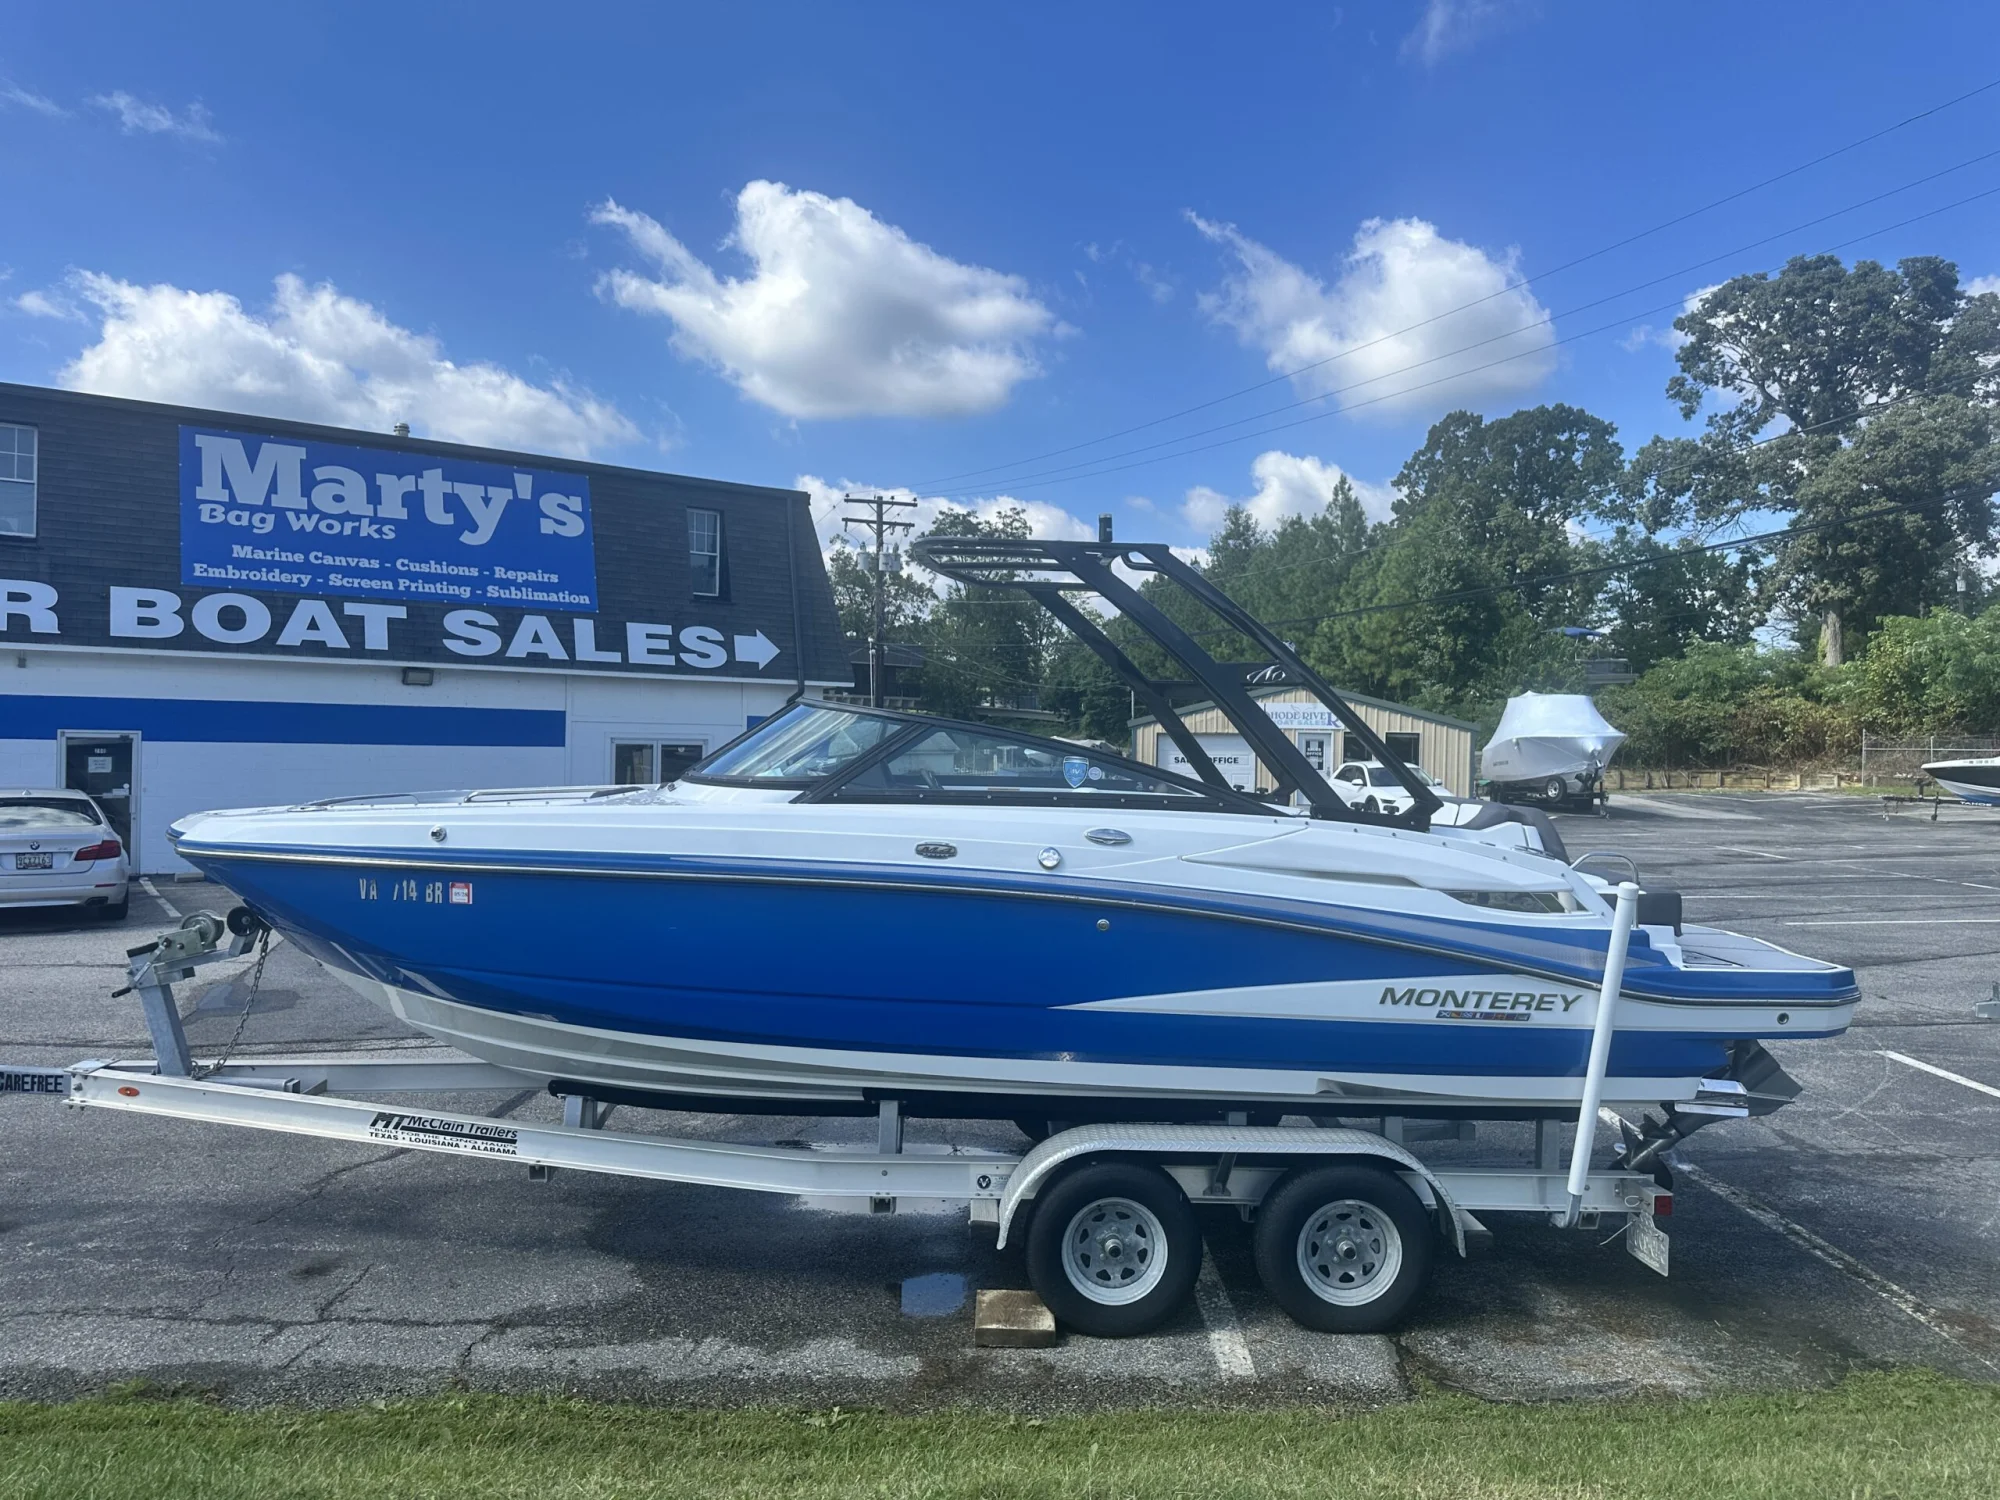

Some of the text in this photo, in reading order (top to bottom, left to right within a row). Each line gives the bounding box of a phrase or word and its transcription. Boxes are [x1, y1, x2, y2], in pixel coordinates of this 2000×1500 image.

[195, 434, 585, 545] Marty's
[198, 503, 396, 540] Bag Works
[231, 544, 304, 563] Marine
[309, 551, 380, 569] Canvas
[396, 558, 479, 576] Cushions
[494, 566, 559, 583] Repairs
[193, 563, 312, 588] Embroidery
[328, 574, 394, 590] Screen
[398, 578, 471, 598] Printing
[486, 585, 590, 604] Sublimation
[110, 585, 407, 650] BOAT
[442, 609, 728, 669] SALES
[359, 878, 378, 899] VA
[425, 882, 442, 903] BR
[1379, 987, 1583, 1012] MONTEREY
[407, 1116, 464, 1132] McClain
[468, 1123, 518, 1139] Trailers
[443, 1136, 478, 1145] LONG
[369, 1132, 517, 1155] TEXAS LOUISIANA ALABAMA
